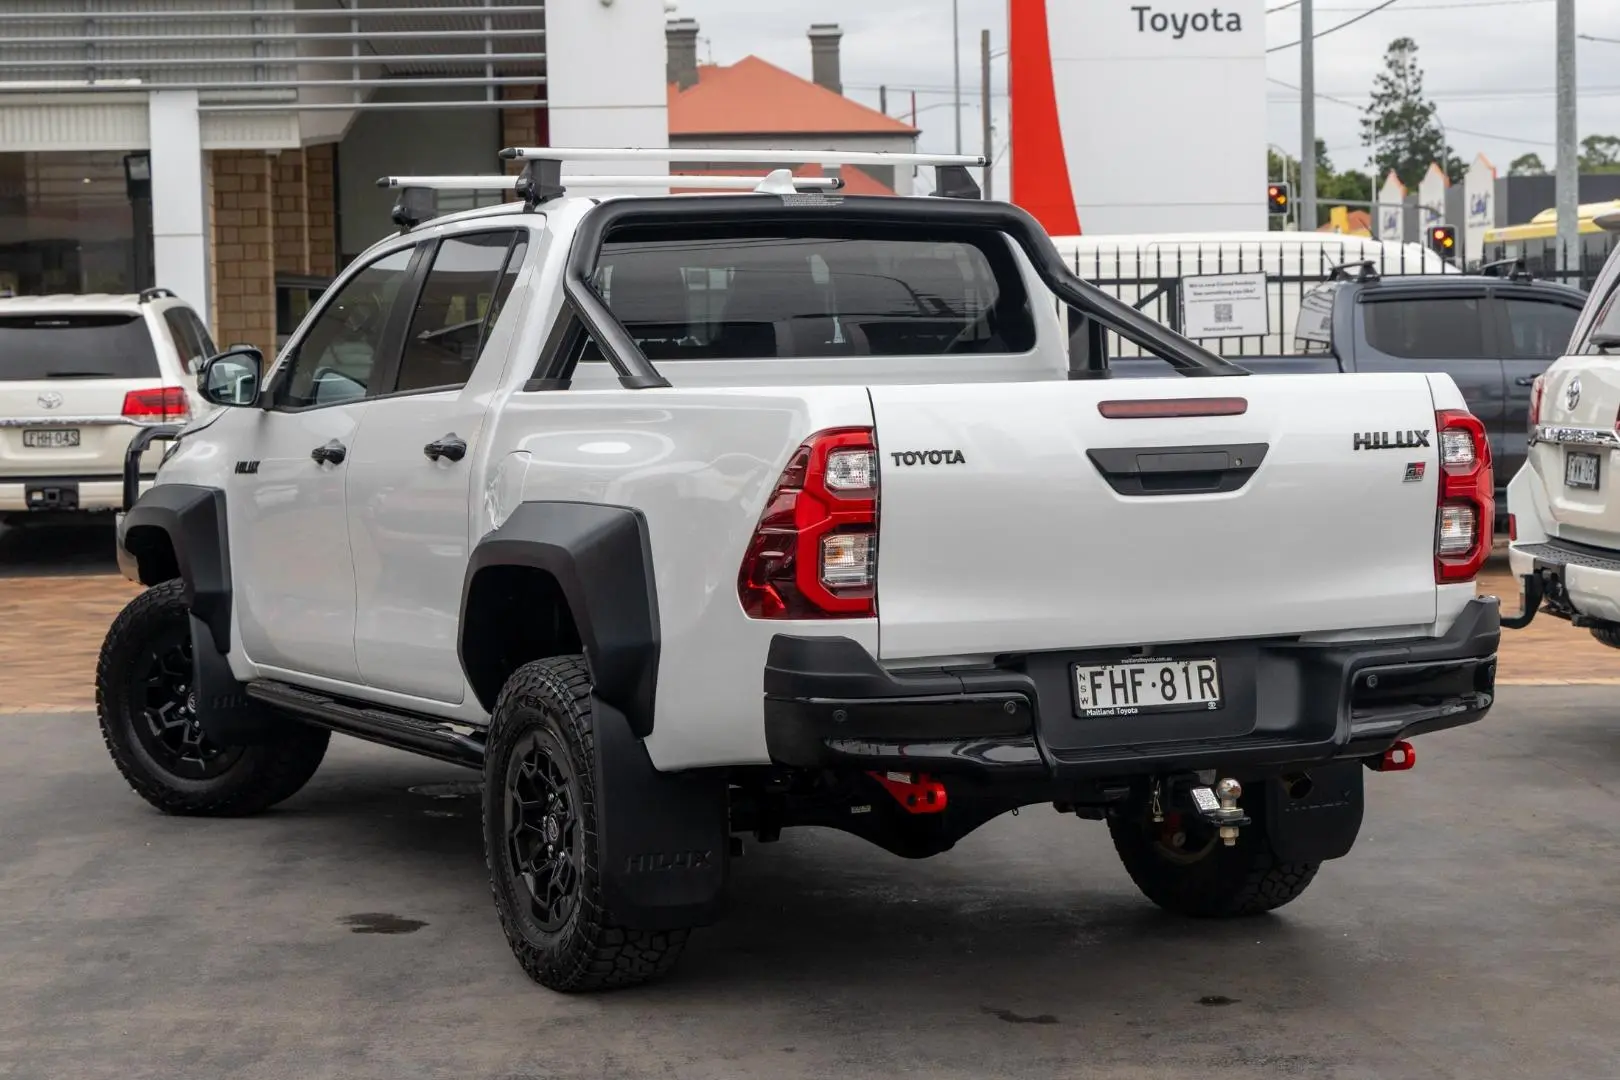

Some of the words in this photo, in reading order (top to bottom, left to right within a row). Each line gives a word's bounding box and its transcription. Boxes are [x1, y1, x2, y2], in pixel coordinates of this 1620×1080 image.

[1131, 6, 1242, 39] Toyota
[1353, 430, 1430, 450] HILUX
[891, 450, 965, 467] TOYOTA
[1086, 708, 1115, 717] Maitland
[1116, 707, 1138, 716] Toyota
[624, 848, 713, 874] HILUX
